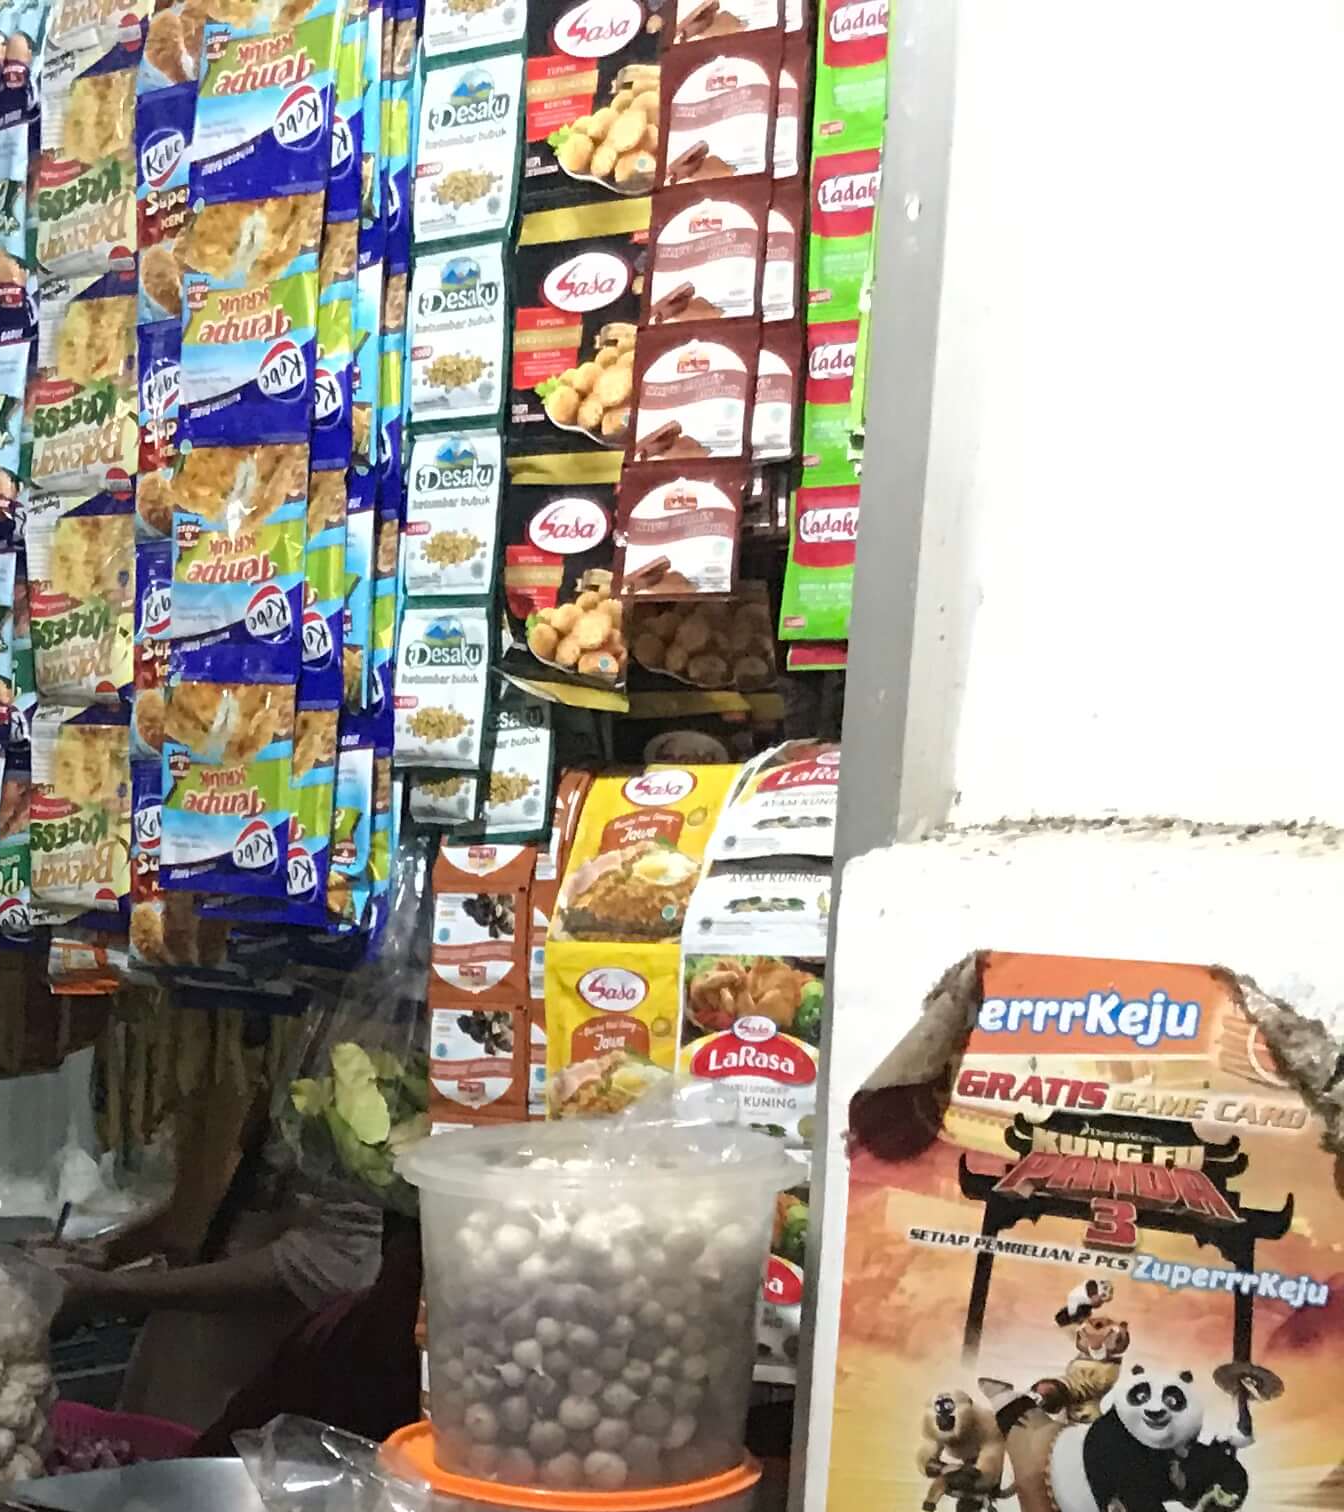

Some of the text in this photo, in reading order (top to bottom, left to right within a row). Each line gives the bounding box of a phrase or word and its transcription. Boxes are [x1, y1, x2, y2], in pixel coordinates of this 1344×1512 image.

[567, 7, 630, 43] Sasa
[237, 33, 294, 64] KRIUK
[216, 54, 314, 95] Tempe
[430, 90, 510, 130] Desaku
[556, 262, 616, 301] Sasa
[217, 288, 272, 315] KRIUK
[418, 282, 499, 317] Desaku
[199, 307, 292, 346] Tempe
[145, 421, 178, 443] Sup
[416, 464, 495, 493] Desaku
[539, 505, 596, 541] Sasa
[188, 552, 277, 584] Tempe
[144, 594, 171, 623] Kob
[405, 641, 483, 670] Desaku
[777, 766, 839, 785] LaRa
[184, 786, 266, 819] Tempe
[588, 973, 637, 1003] Sasa
[972, 994, 1199, 1045] errrKeju
[708, 1045, 796, 1076] LaRasa
[743, 1095, 798, 1109] KUNING
[957, 1068, 1309, 1130] GRATIS GAME CARD
[1032, 1128, 1205, 1171] KUNG FU
[992, 1151, 1246, 1222] PANDA
[1084, 1197, 1137, 1250] 3
[909, 1228, 1329, 1307] SETIAP PEMBELIAN 2 PCS ZuperrrKeju
